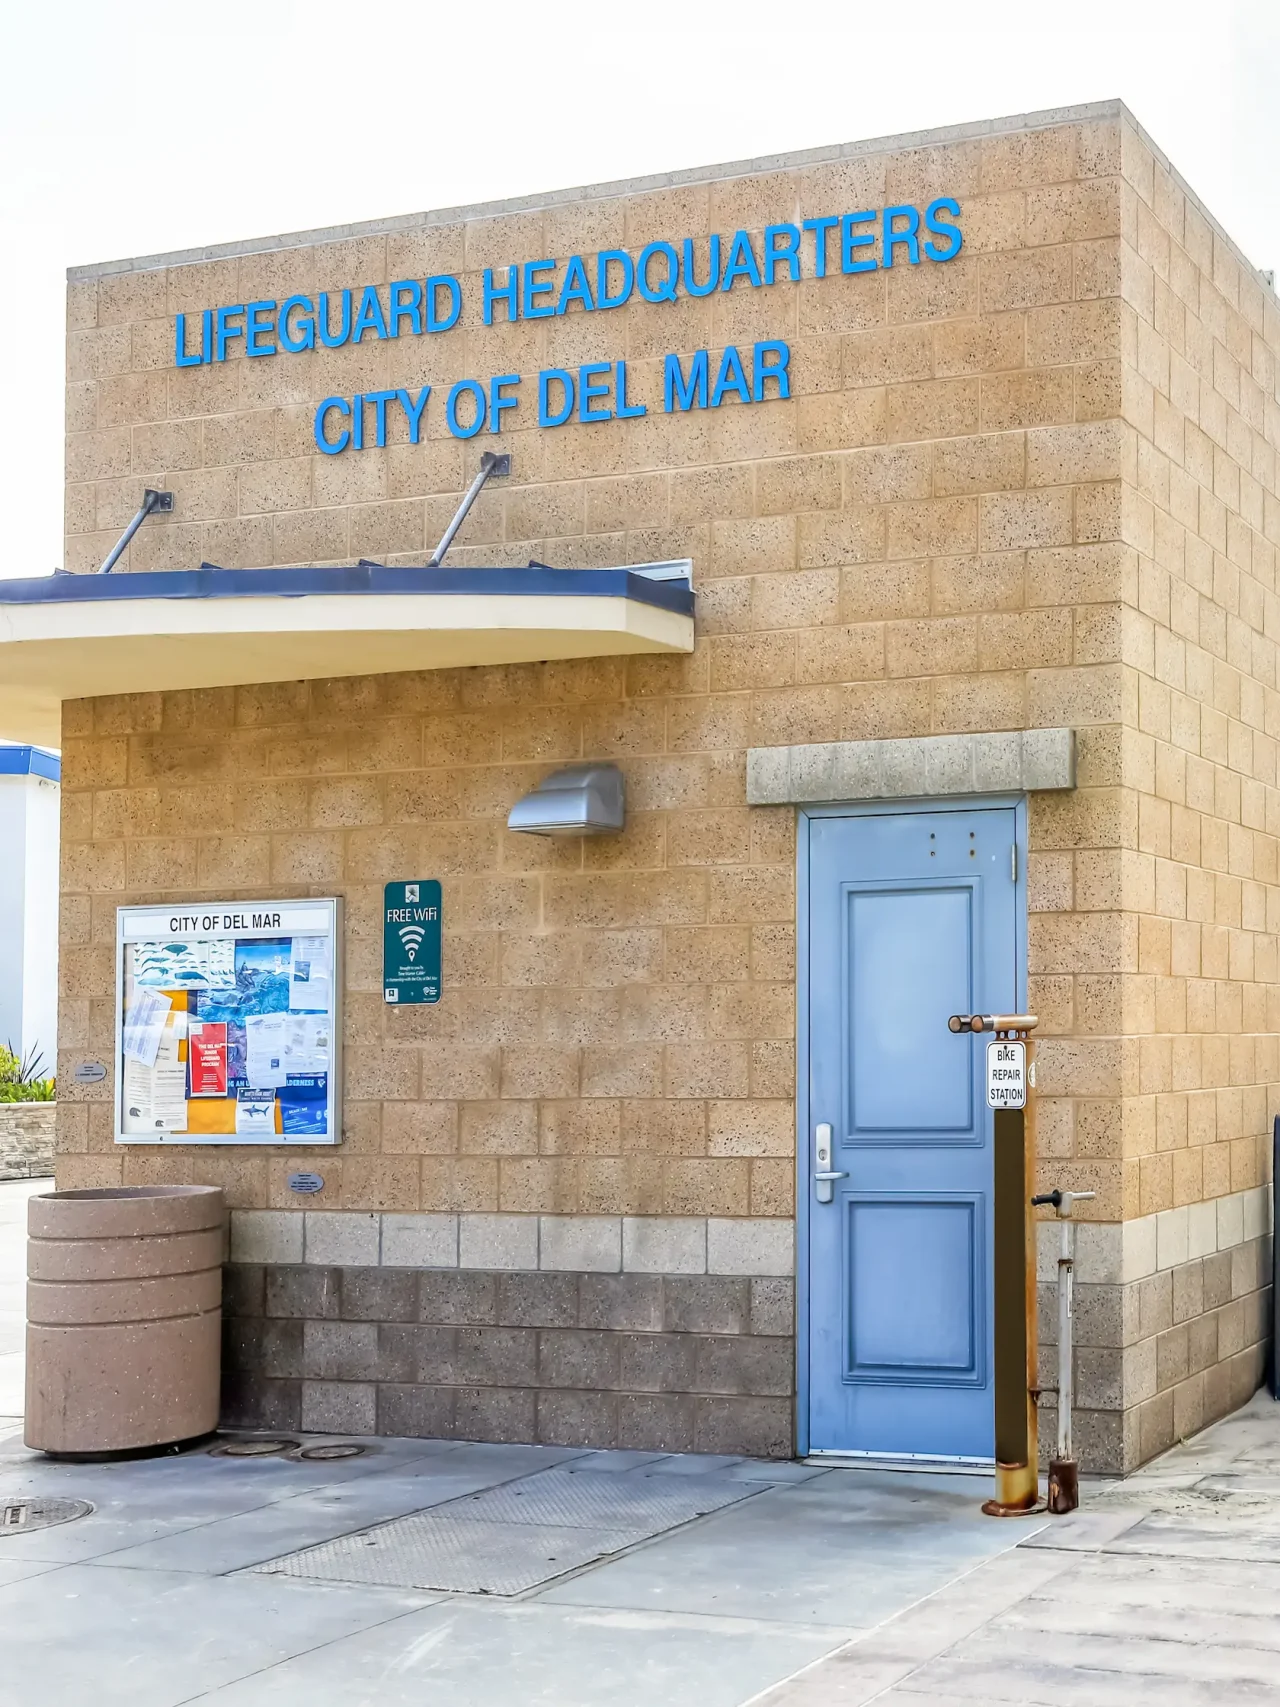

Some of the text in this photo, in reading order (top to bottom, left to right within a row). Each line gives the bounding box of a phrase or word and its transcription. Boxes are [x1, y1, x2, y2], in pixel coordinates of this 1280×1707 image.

[175, 197, 964, 368] LIFEGUARD HEADQUARTERS
[314, 340, 791, 455] CITY OF DEL MAR
[169, 913, 281, 932] CITY OF DEL MAR
[387, 907, 437, 923] FREE WiFi
[997, 1049, 1016, 1061] BIKE
[992, 1069, 1021, 1081] REPAIR
[990, 1088, 1023, 1100] STATION
